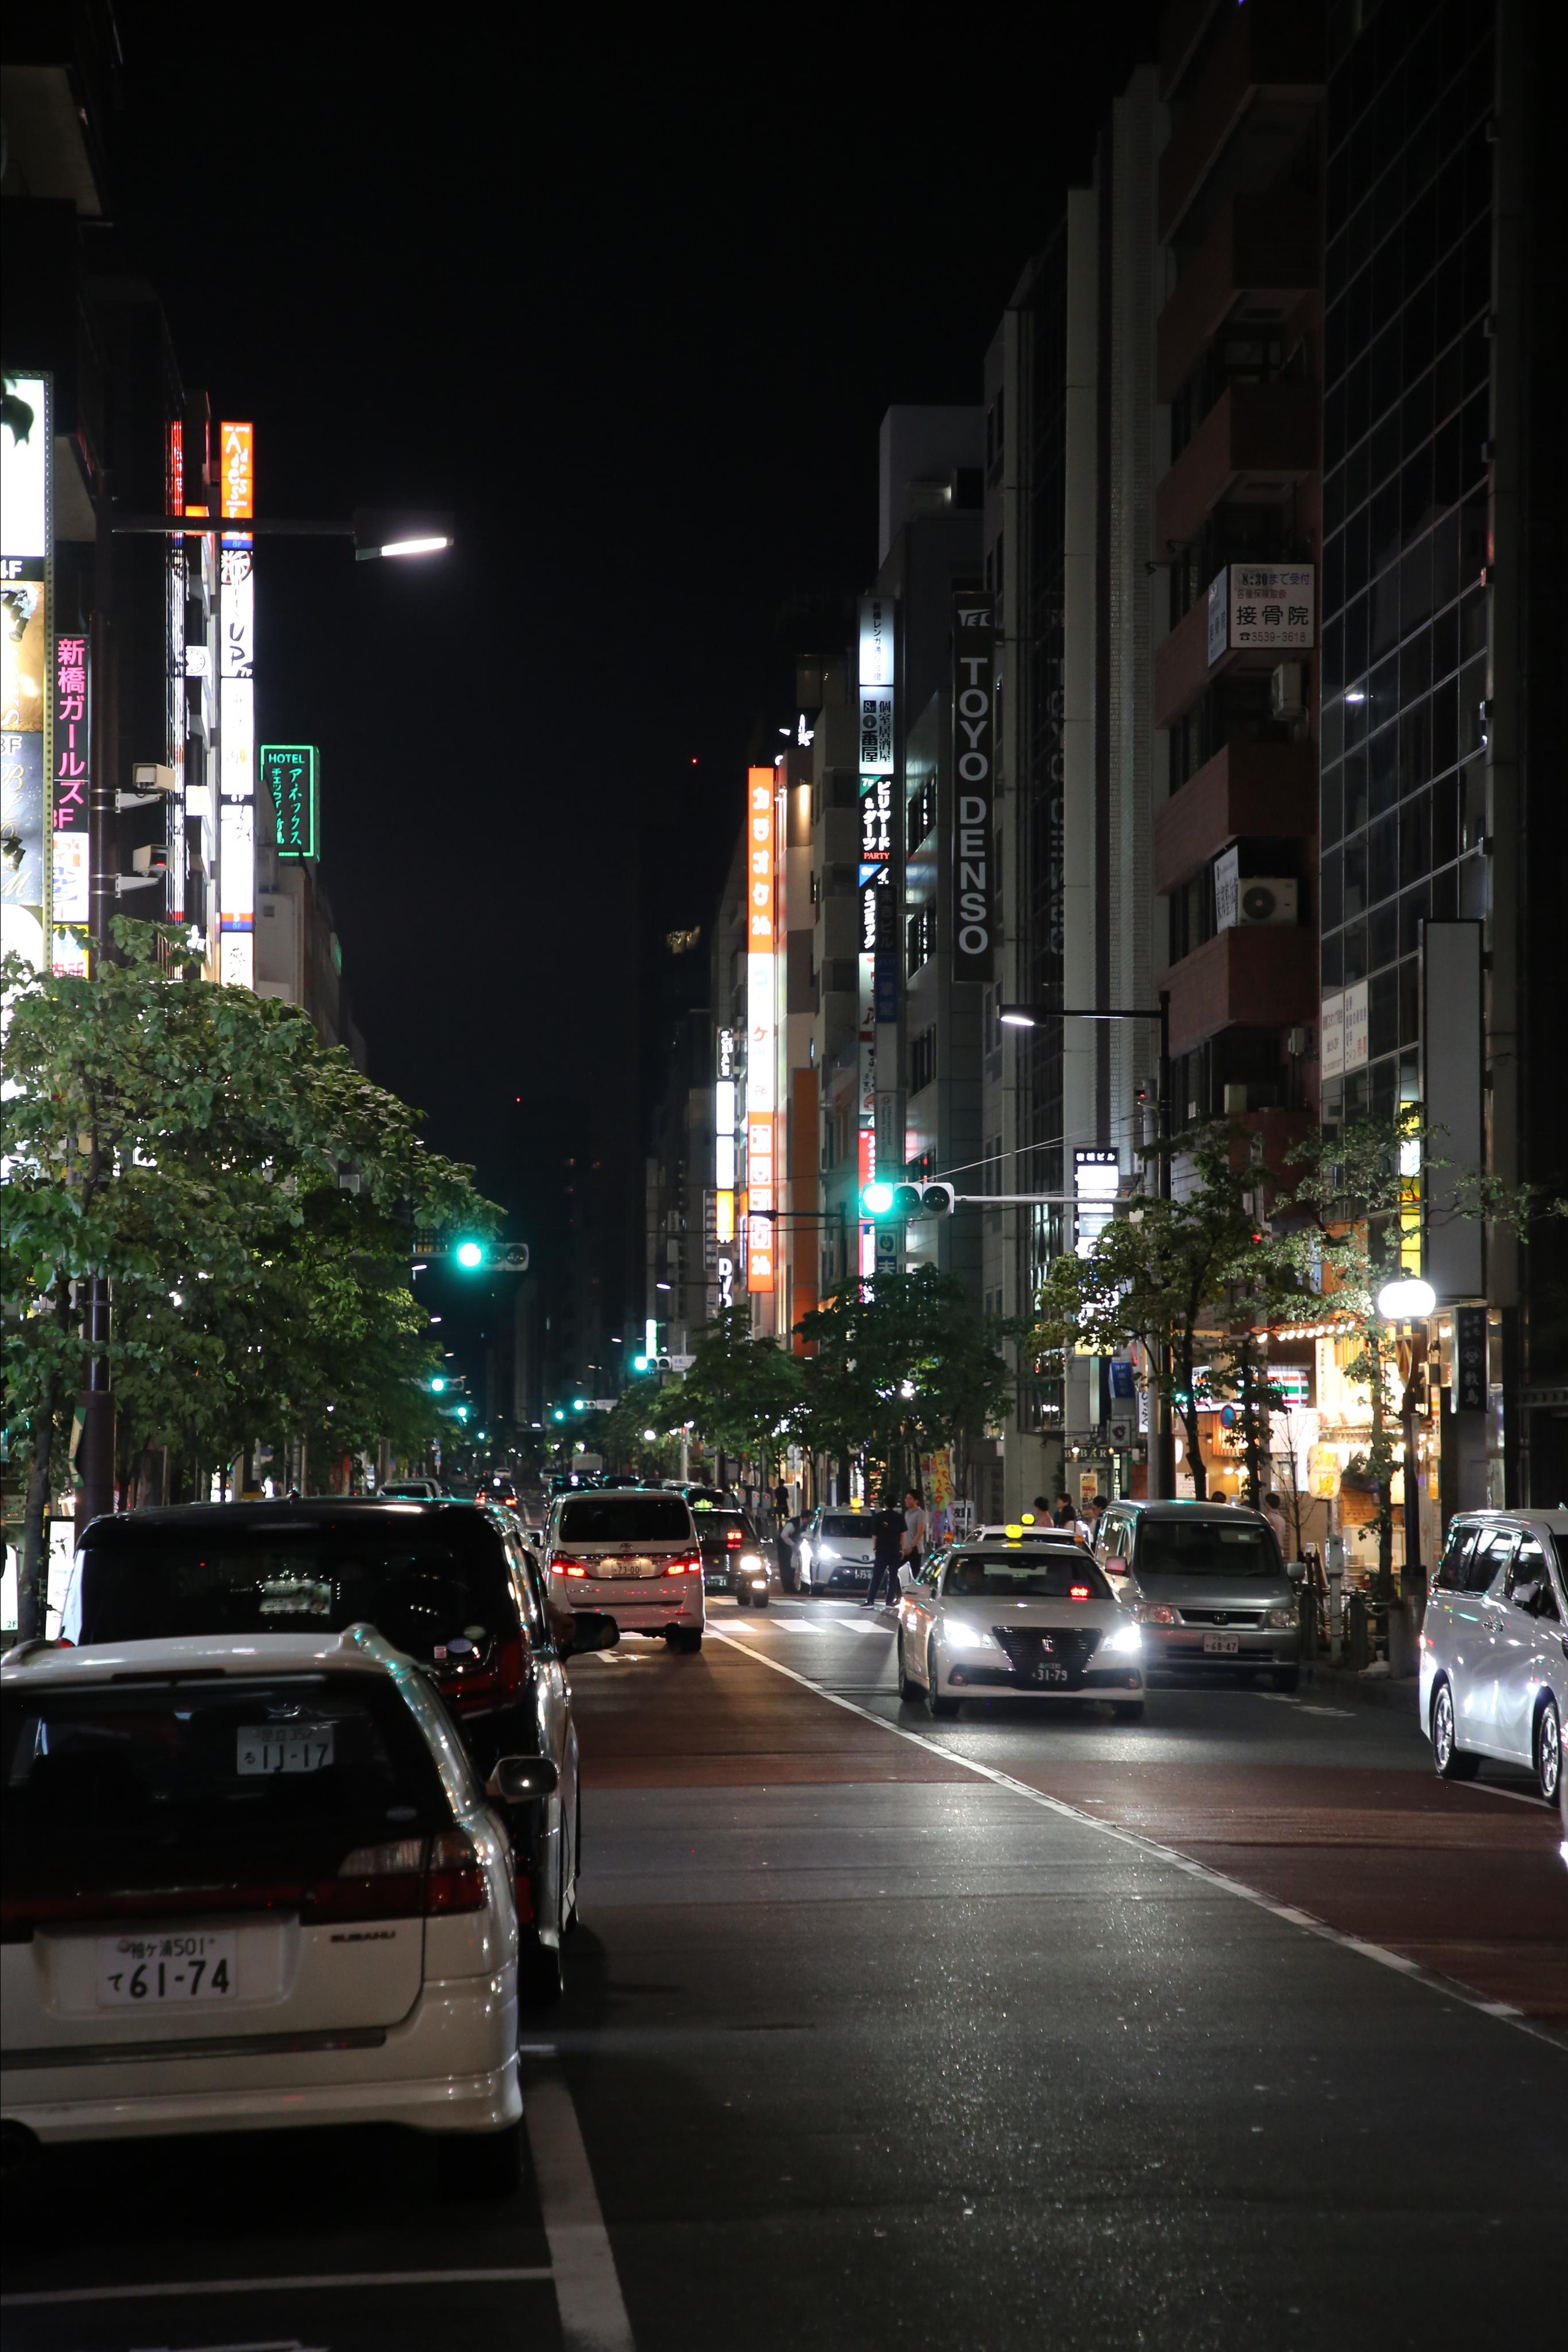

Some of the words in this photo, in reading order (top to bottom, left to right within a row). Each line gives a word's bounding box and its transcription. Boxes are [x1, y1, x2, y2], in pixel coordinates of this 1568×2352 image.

[1236, 605, 1309, 626] 接骨院
[57, 639, 85, 805] 新橋ガールズ
[959, 657, 989, 781] TOYO
[268, 753, 305, 764] HOTEL
[288, 768, 303, 845] アネックス
[959, 796, 989, 955] DENSO
[1212, 1642, 1237, 1652] 68-47
[1038, 1670, 1068, 1681] 31-79
[330, 1931, 396, 1943] SUBARU
[129, 1958, 230, 1999] 61-74
